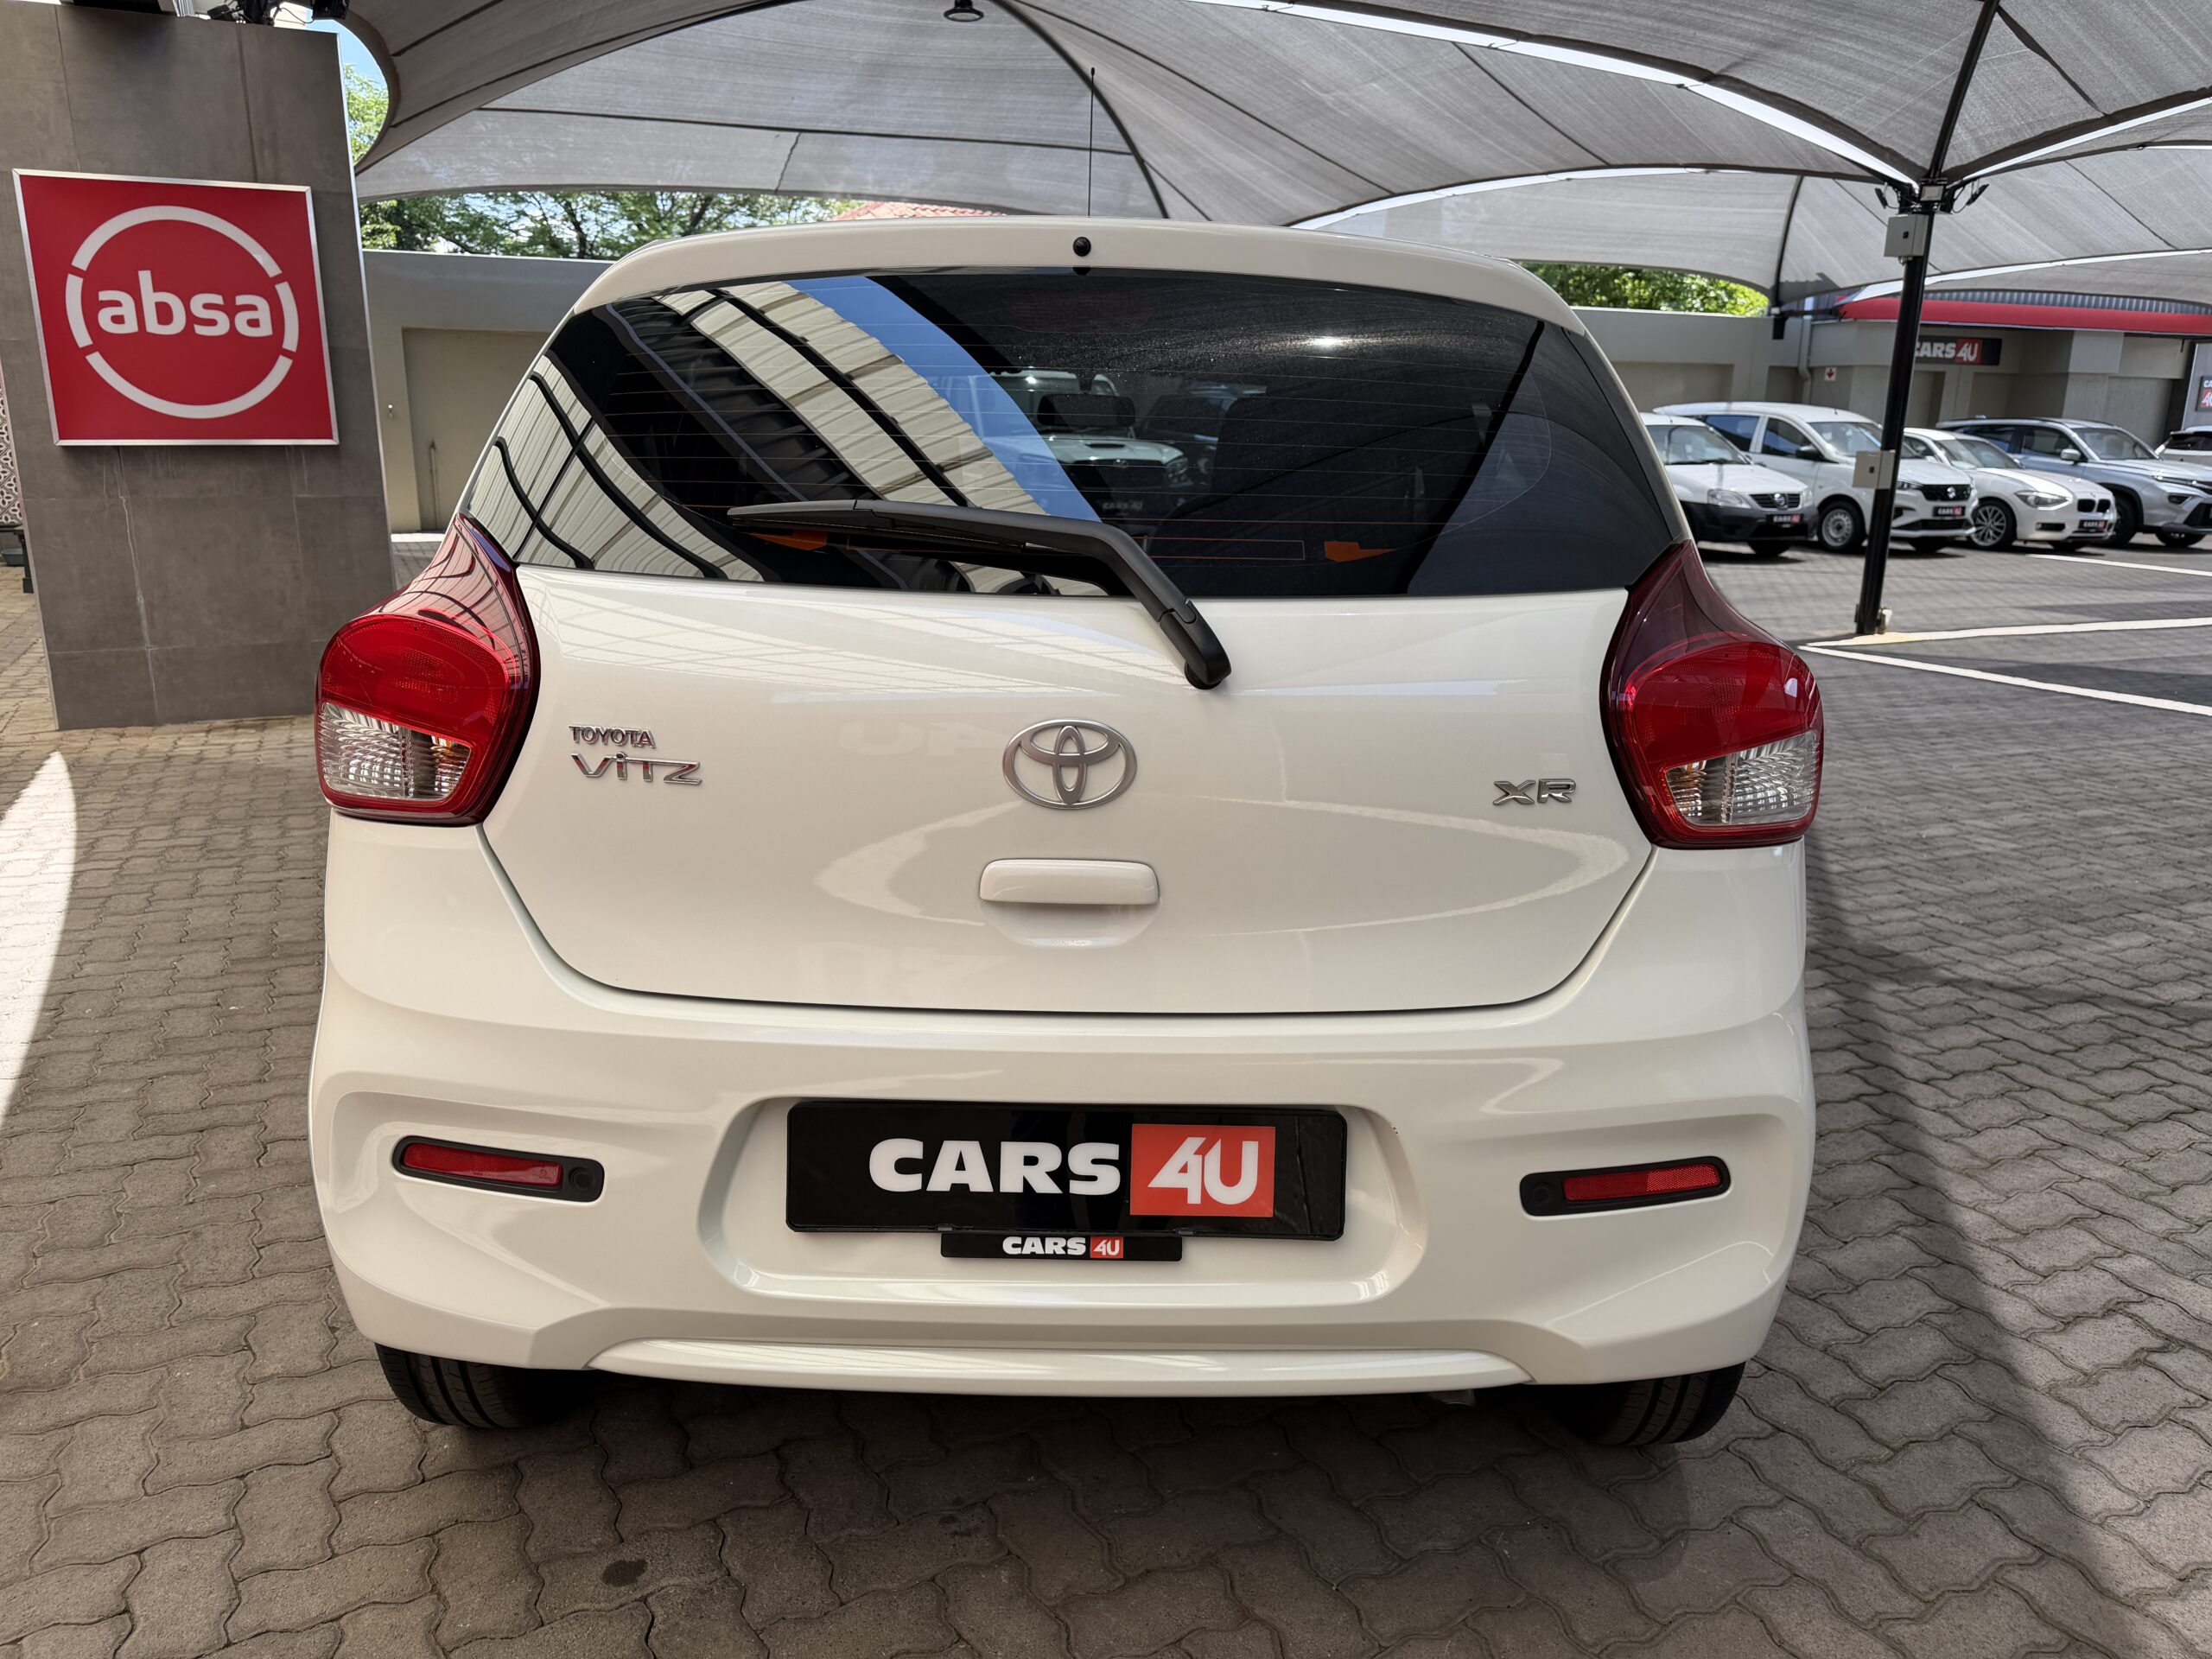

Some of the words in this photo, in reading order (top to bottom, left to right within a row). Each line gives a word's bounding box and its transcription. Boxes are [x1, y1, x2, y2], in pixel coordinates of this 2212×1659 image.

[98, 270, 273, 338] absa
[1956, 343, 1979, 362] 4U
[569, 723, 657, 749] TOYOTA
[1492, 778, 1577, 806] XR
[868, 1138, 1122, 1196] CARS
[1147, 1136, 1260, 1206] 4U
[1002, 1236, 1087, 1255] CARS
[1092, 1239, 1120, 1256] 4U
